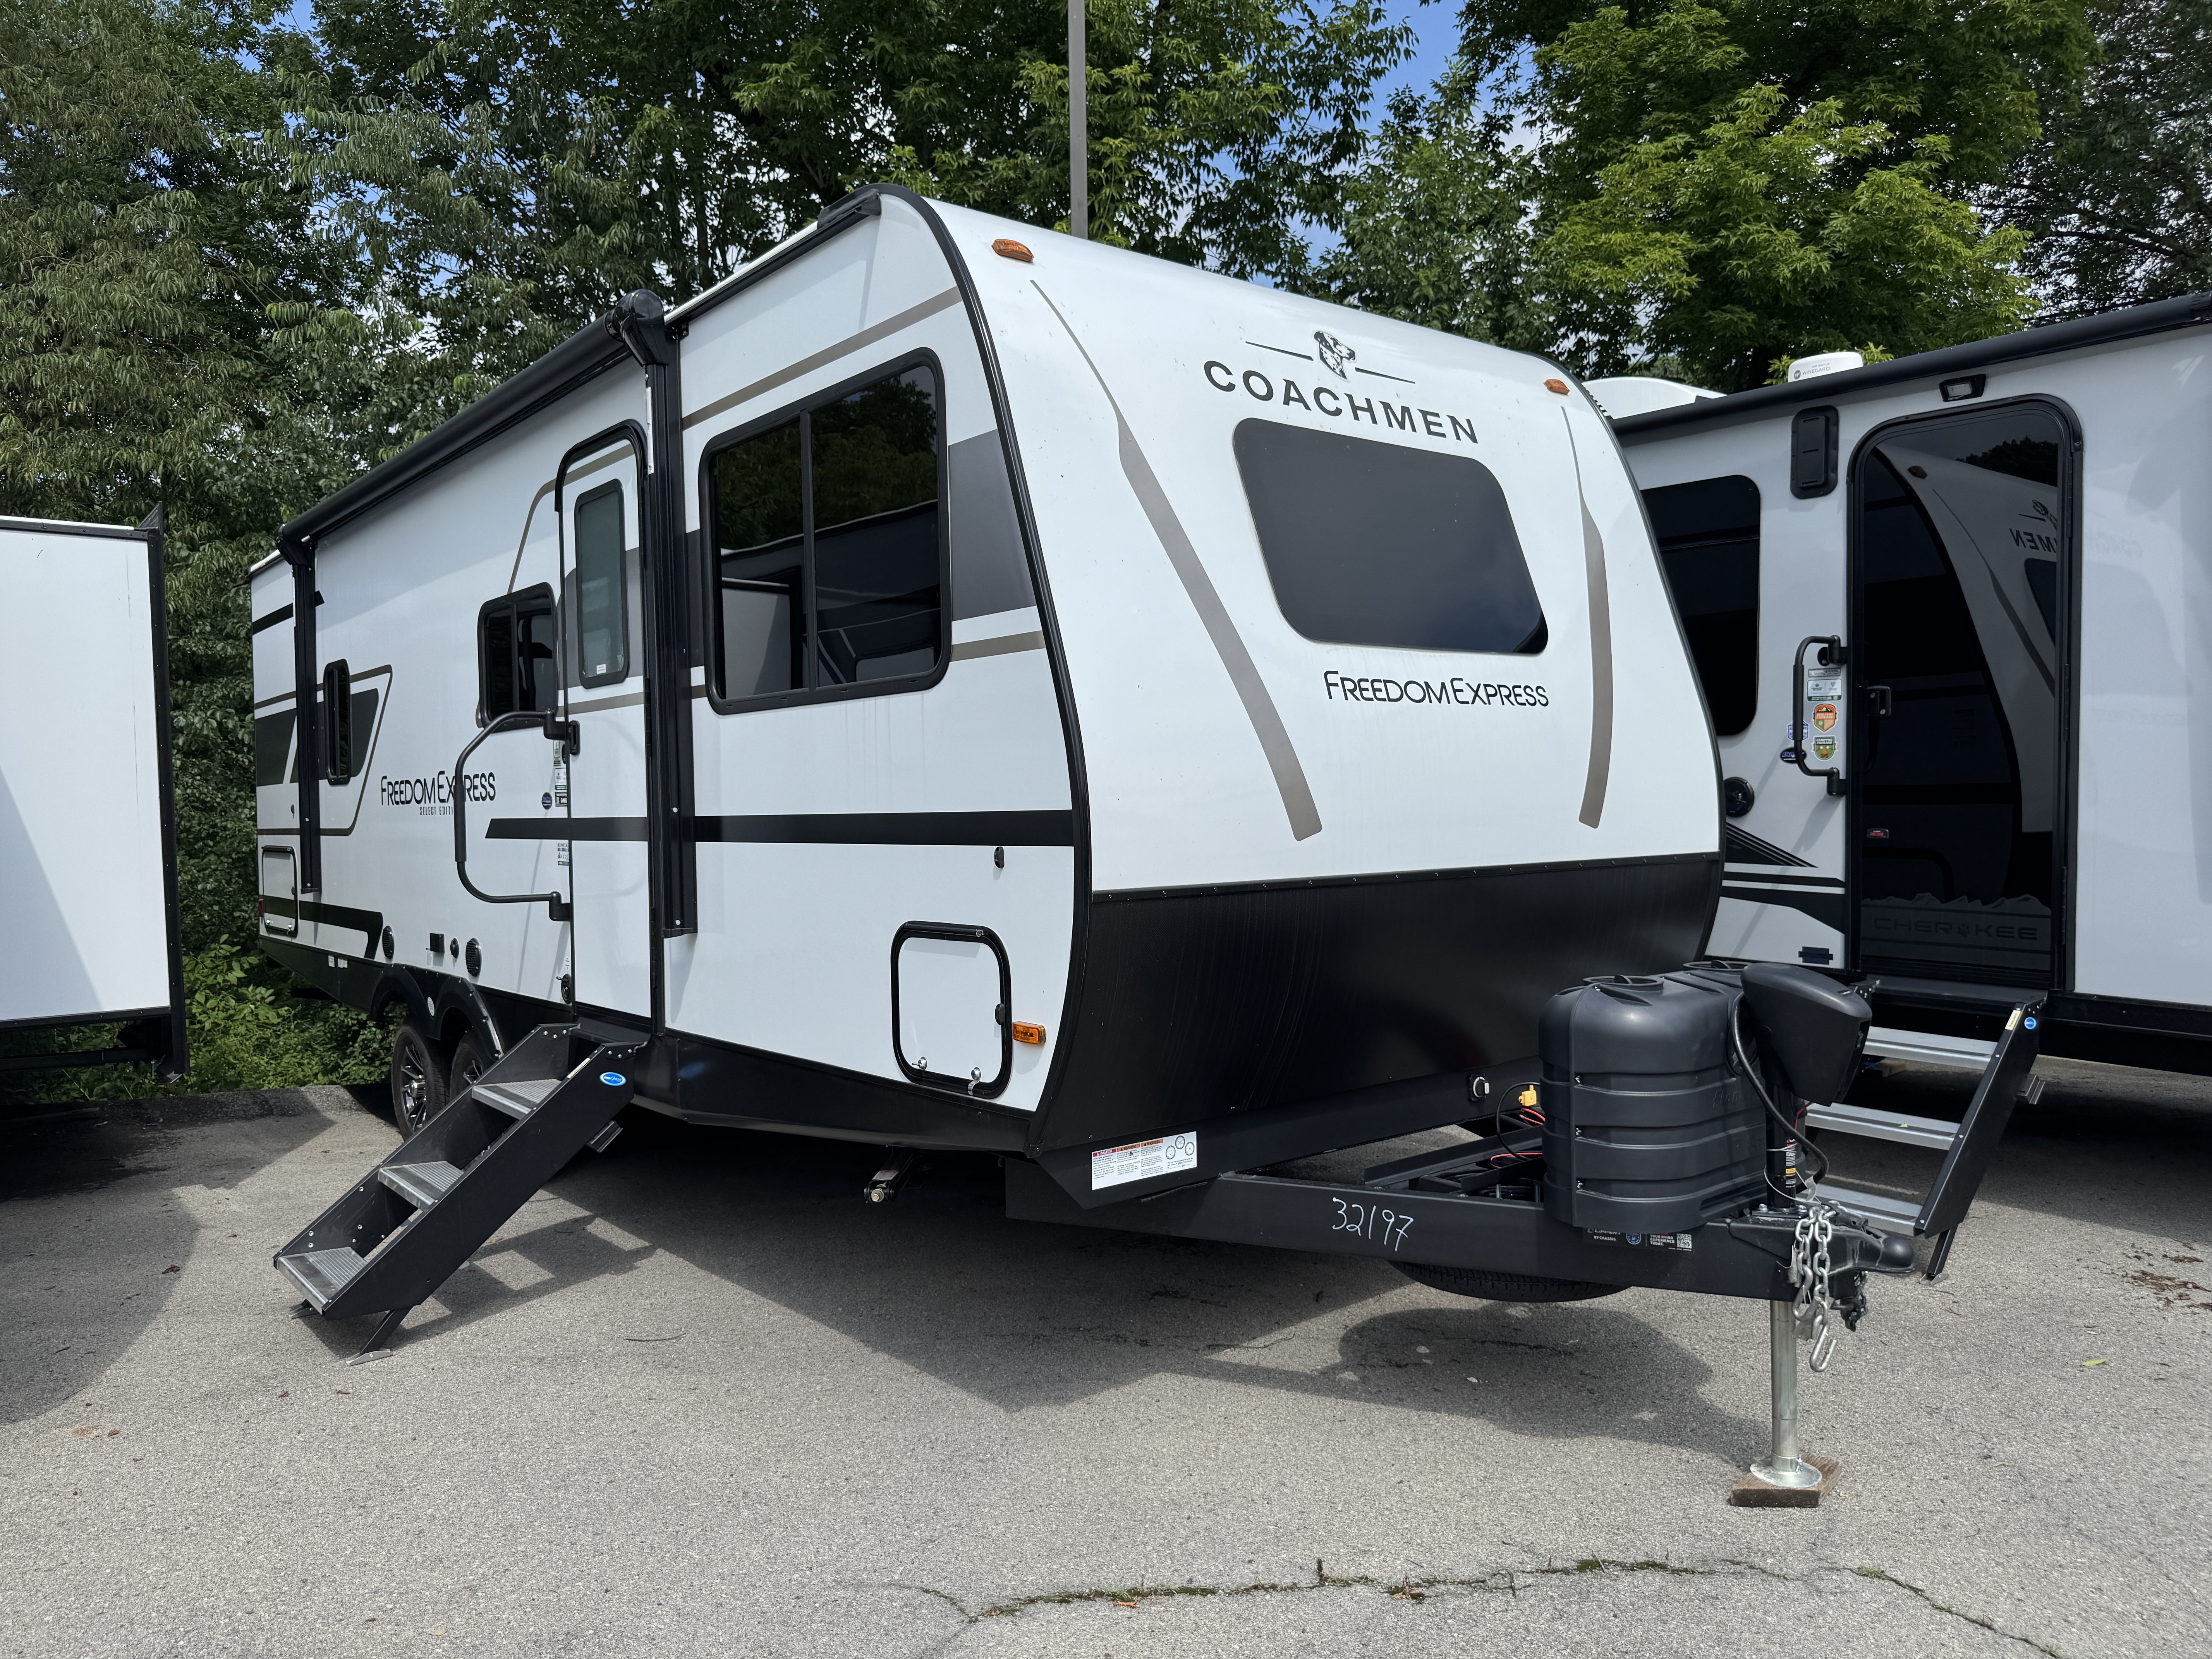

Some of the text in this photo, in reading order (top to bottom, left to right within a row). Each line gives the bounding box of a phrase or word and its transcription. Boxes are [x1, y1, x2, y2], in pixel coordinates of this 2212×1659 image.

[1803, 366, 1830, 374] WINEGARD
[1204, 361, 1478, 444] COACHMEN
[381, 770, 496, 806] FREEDOMEXRESS
[420, 806, 453, 815] SELECT EDITI
[1332, 1197, 1414, 1252] 32197
